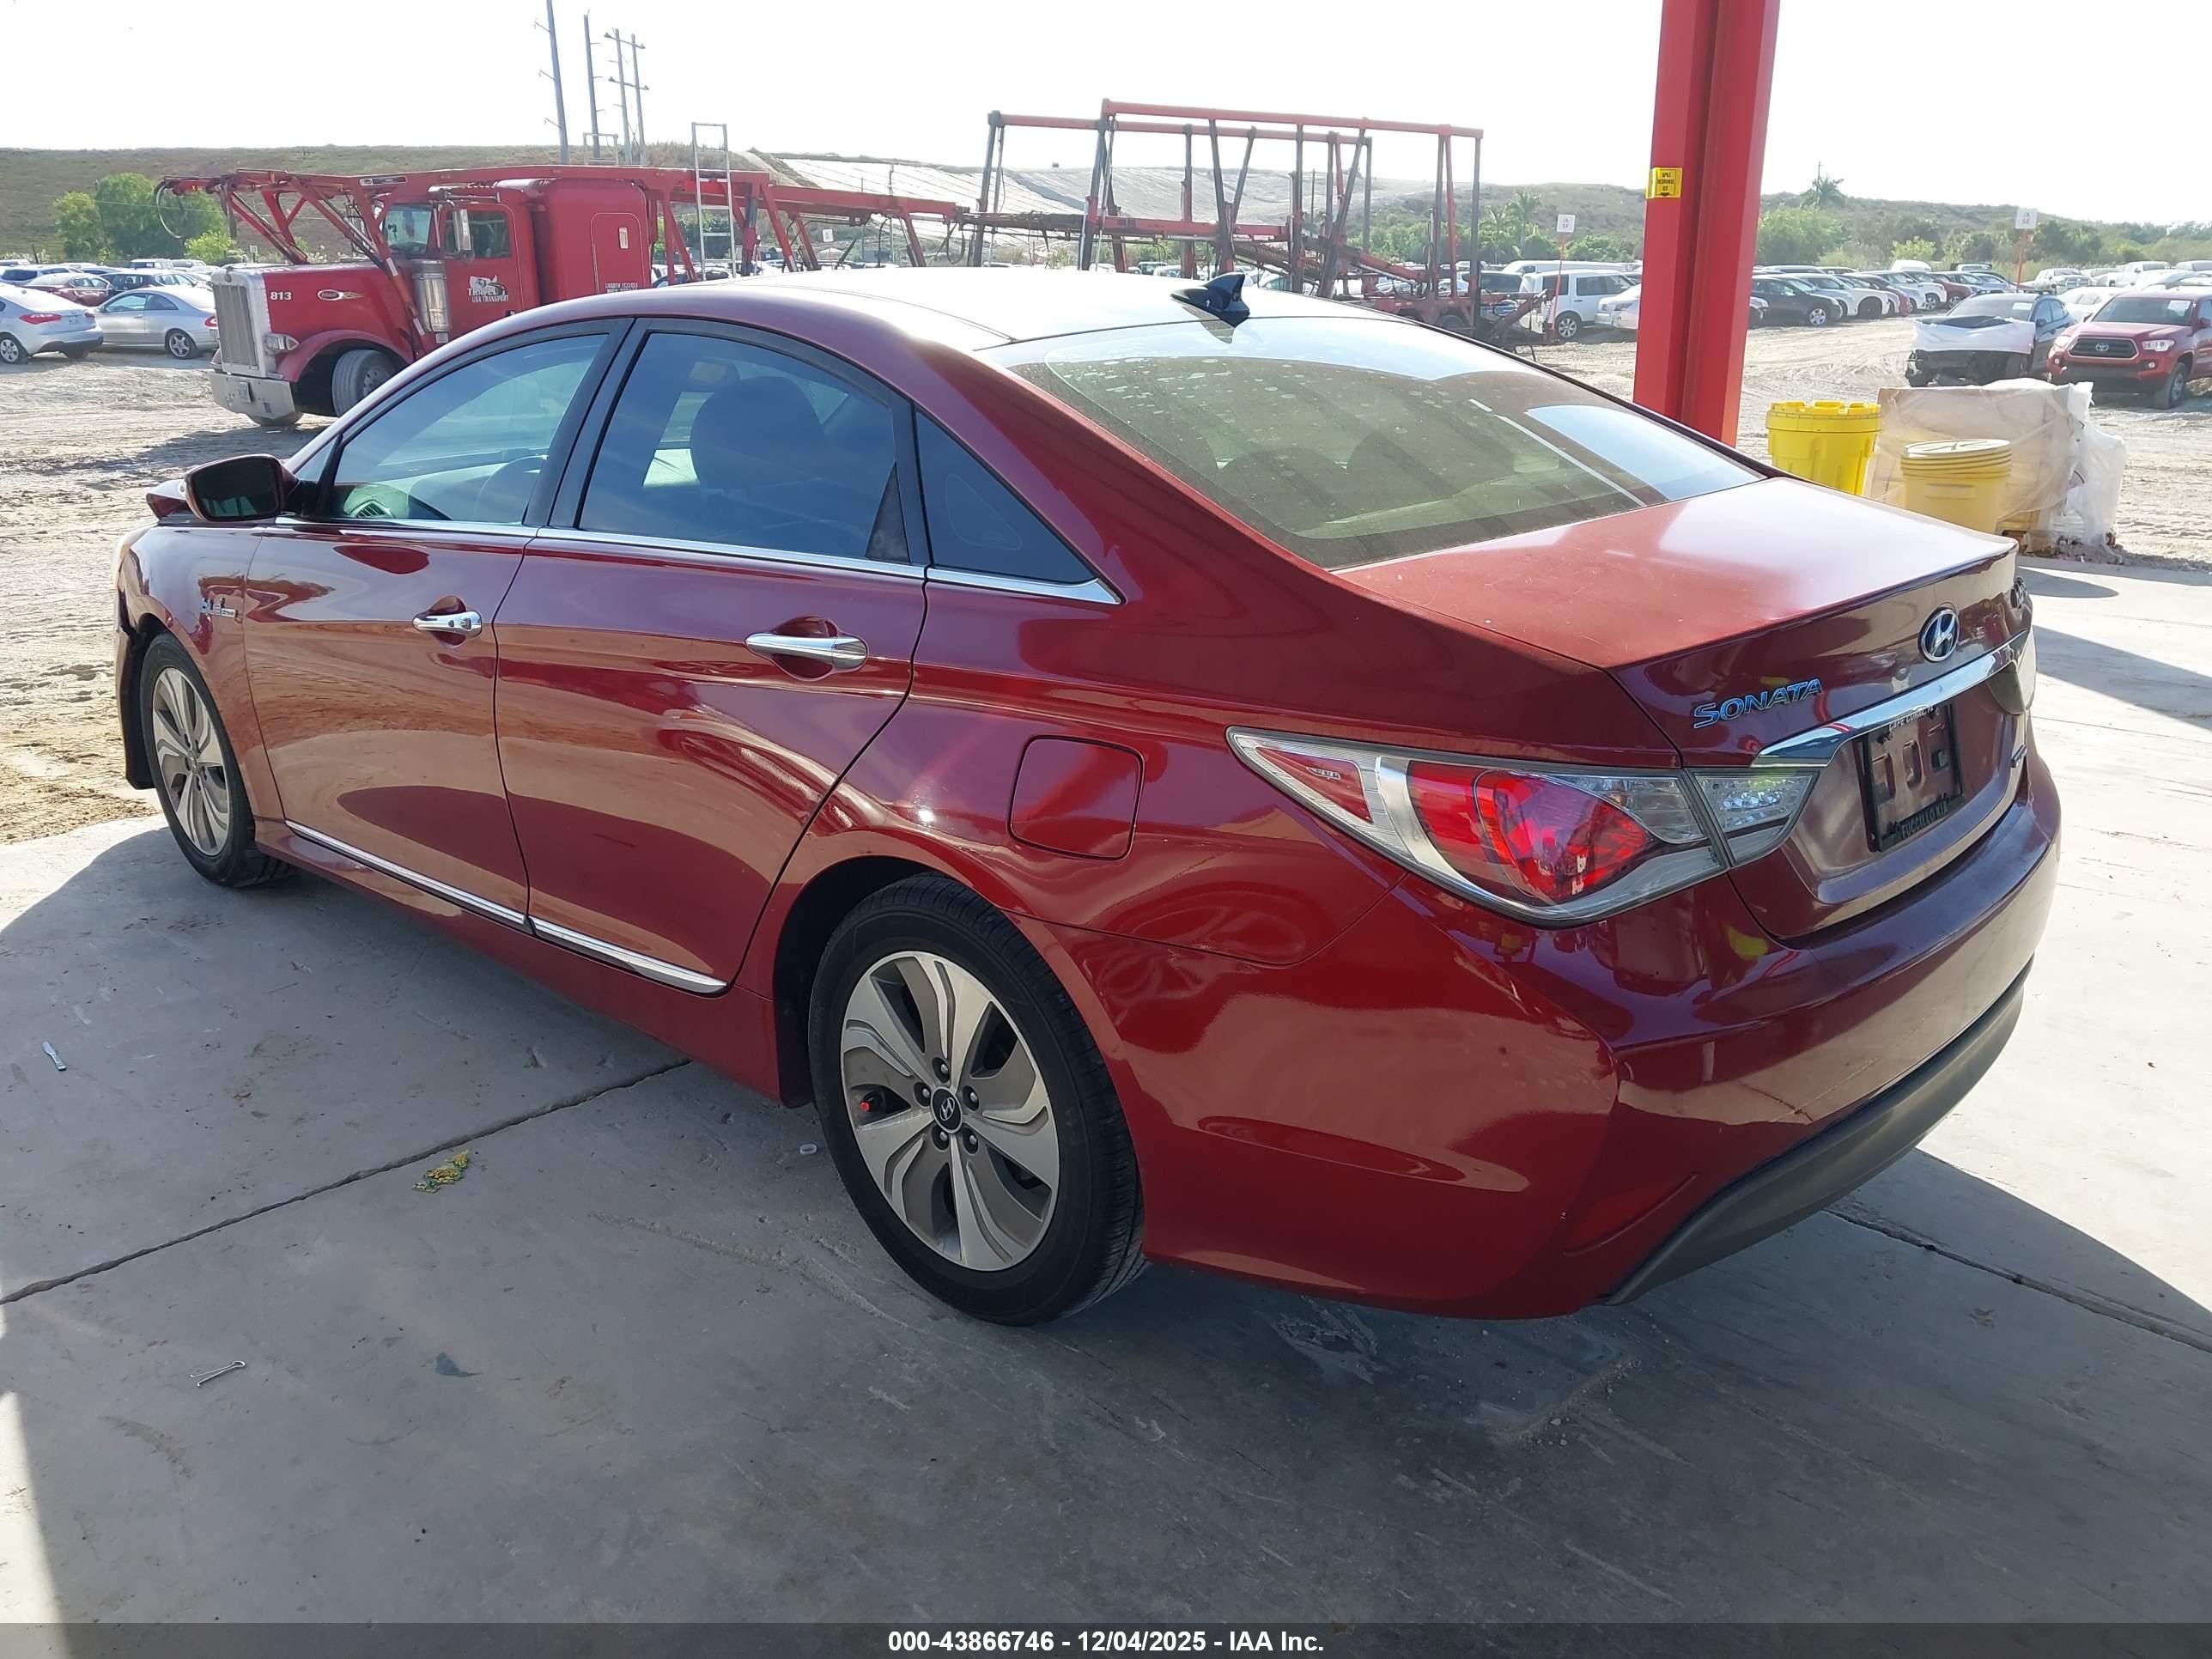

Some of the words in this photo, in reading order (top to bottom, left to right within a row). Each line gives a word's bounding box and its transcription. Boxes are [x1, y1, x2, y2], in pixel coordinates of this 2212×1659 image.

[270, 291, 292, 301] 813
[483, 295, 509, 303] TRANSPORT
[1693, 678, 1823, 729] SONATA
